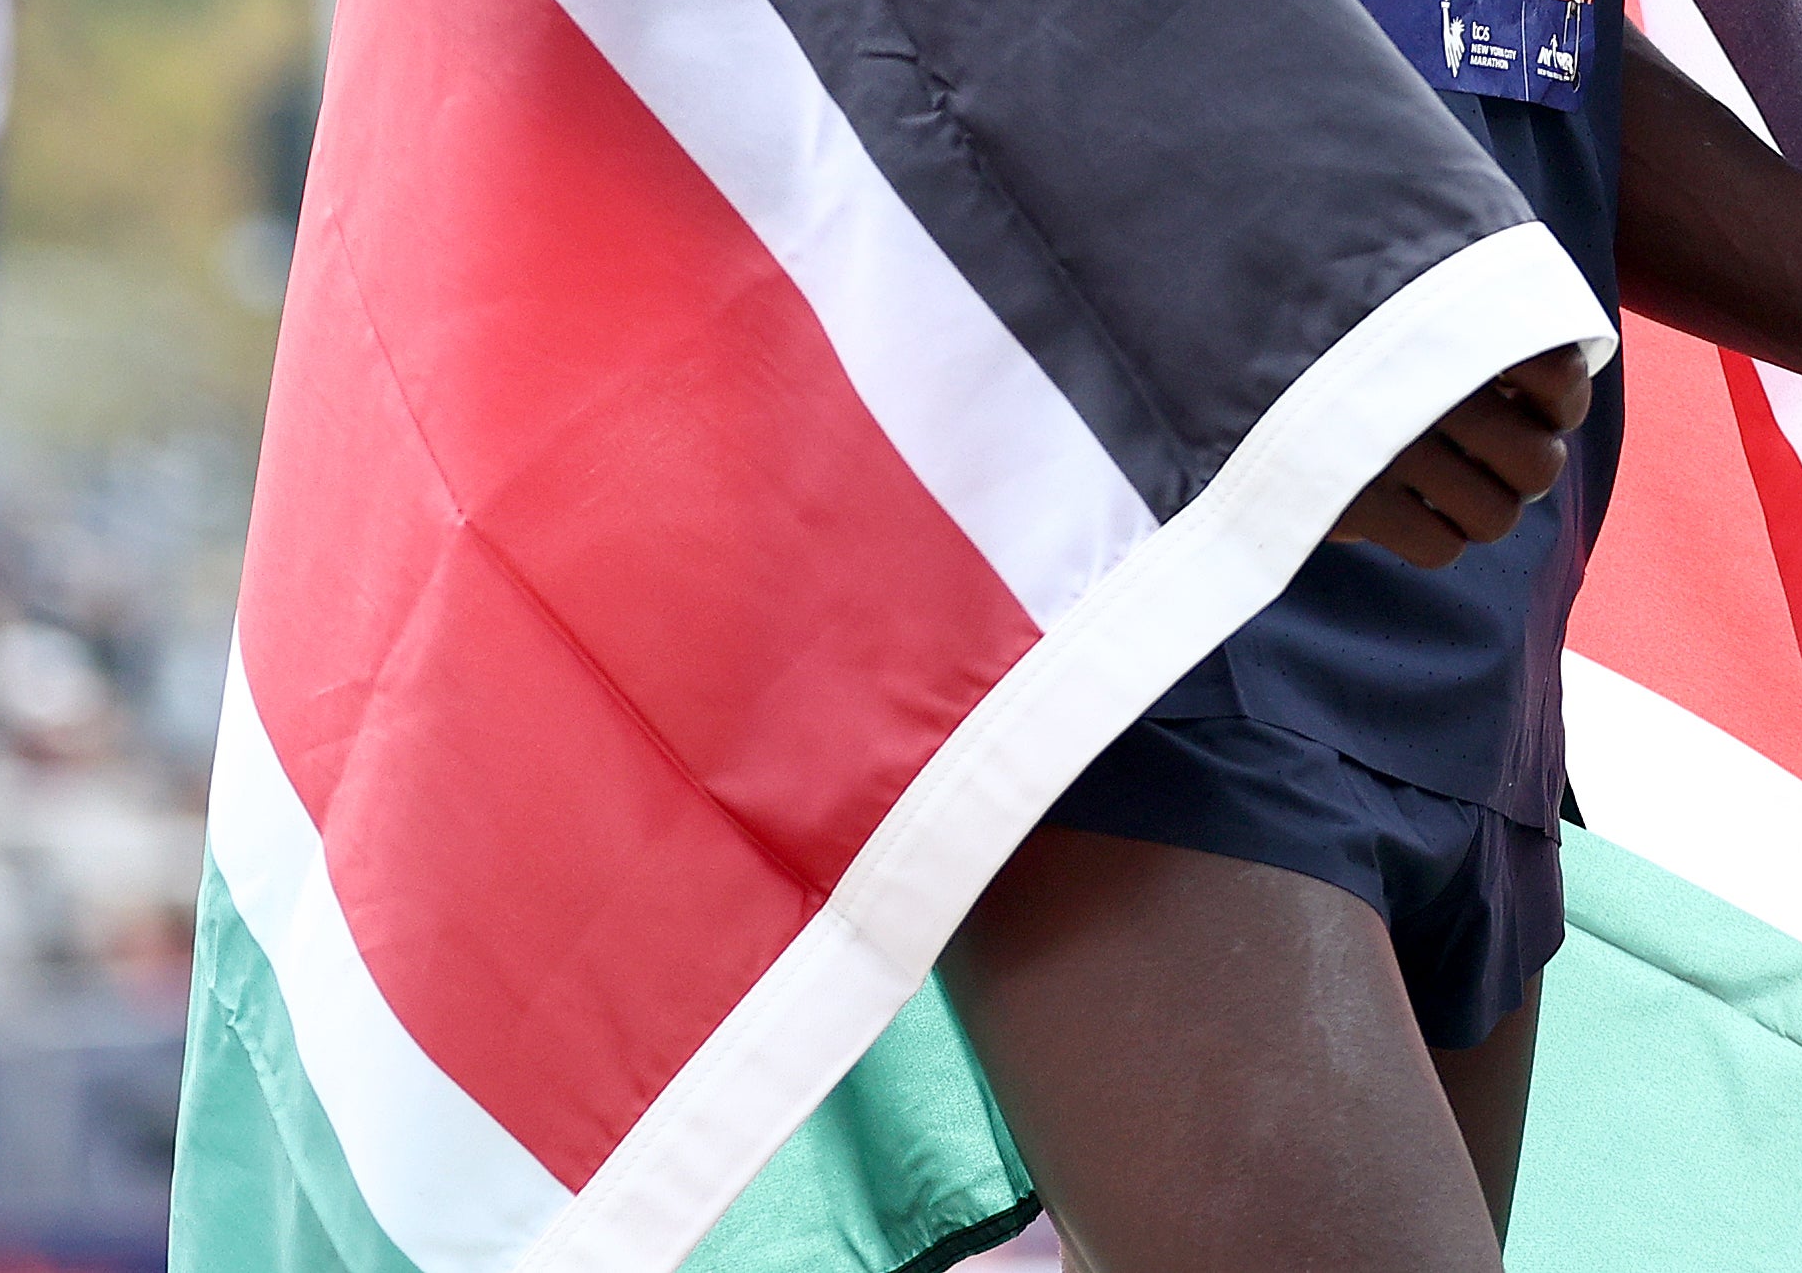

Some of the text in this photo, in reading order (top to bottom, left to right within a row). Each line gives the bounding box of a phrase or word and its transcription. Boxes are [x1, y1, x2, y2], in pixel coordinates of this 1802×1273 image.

[1472, 21, 1490, 41] tcs
[1471, 43, 1489, 54] NEW
[1470, 55, 1508, 70] MARATHON
